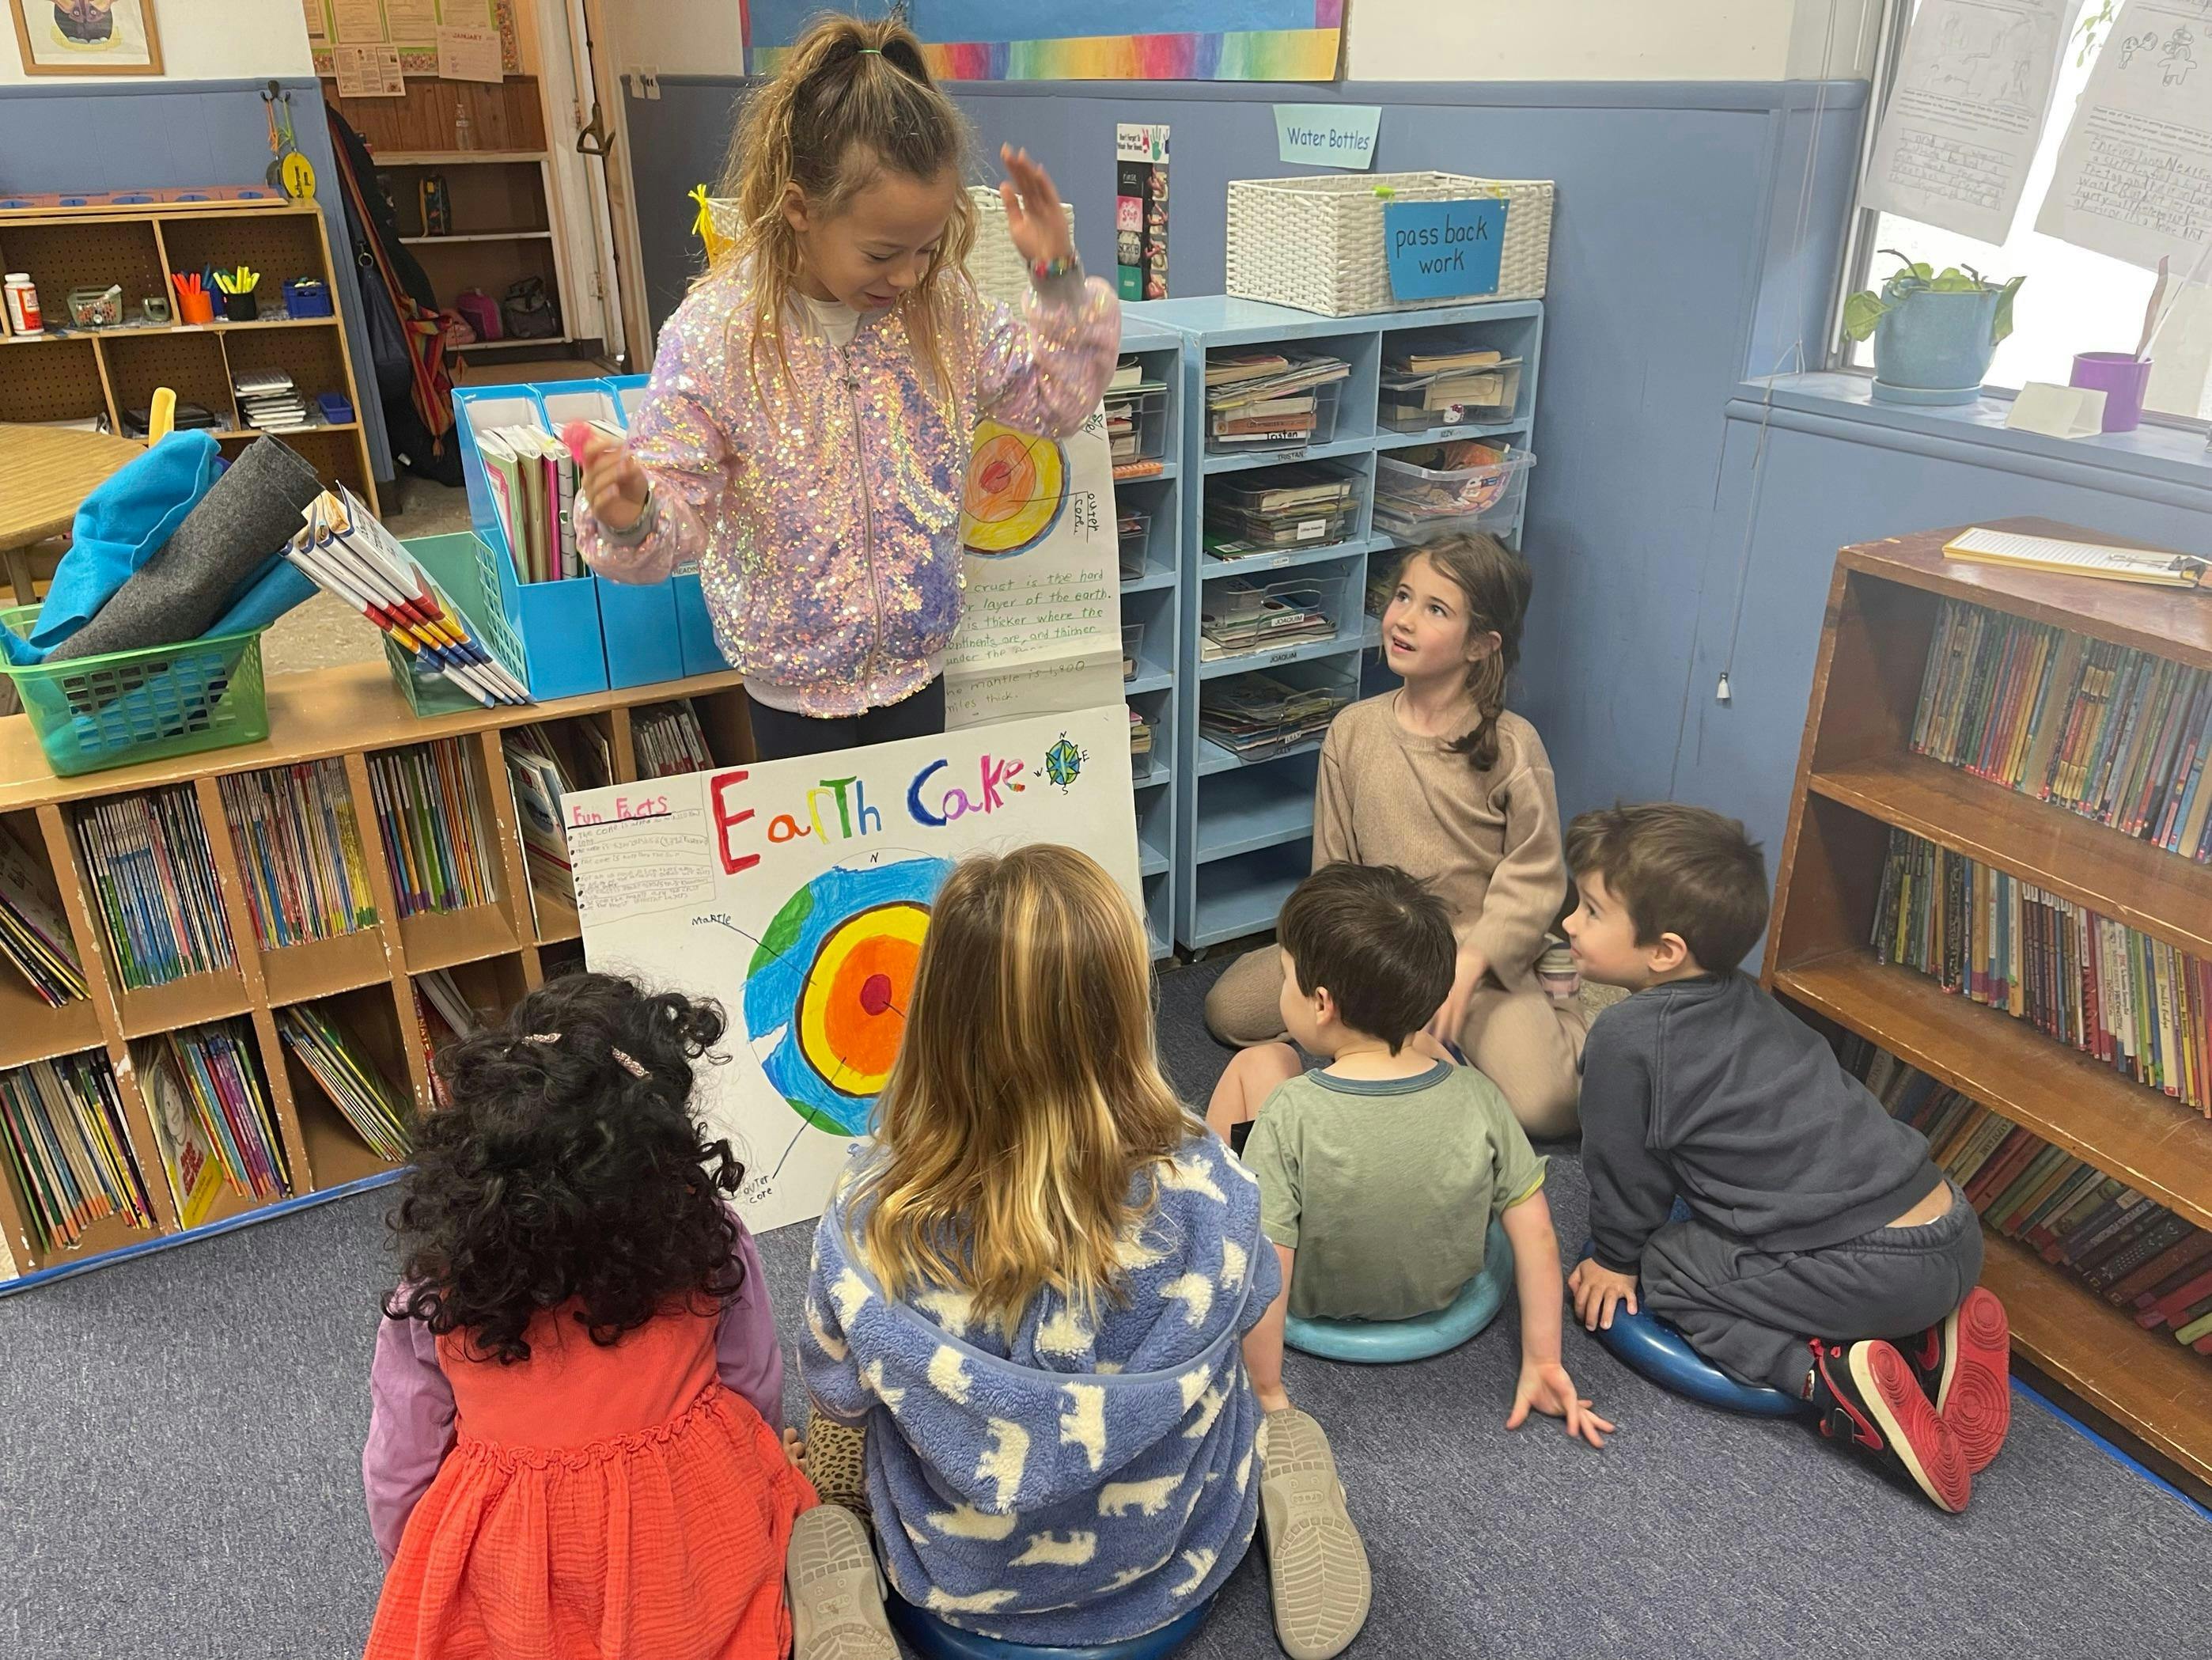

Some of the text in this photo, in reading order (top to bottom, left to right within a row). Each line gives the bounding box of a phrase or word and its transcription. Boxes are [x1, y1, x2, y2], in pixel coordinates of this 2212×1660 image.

[1287, 127, 1370, 150] Water Bottles
[1396, 214, 1487, 258] pass back
[1119, 244, 1138, 255] SCRUB
[1419, 248, 1464, 274] work
[1266, 430, 1298, 440] Tristan
[1278, 450, 1304, 460] TRISTAN
[673, 567, 696, 575] READIN
[974, 569, 1103, 593] crust is the hard
[983, 598, 1016, 613] layer
[1025, 593, 1044, 604] of
[1050, 588, 1069, 601] the
[1075, 589, 1111, 601] earth.
[968, 617, 978, 630] is
[1037, 611, 1073, 623] where
[1082, 608, 1103, 618] the
[1275, 615, 1302, 625] JOAQUIM
[1030, 628, 1048, 641] and
[1270, 652, 1297, 663] JOAQUIM
[970, 674, 1020, 691] mantle
[1082, 749, 1090, 762] E
[1033, 767, 1043, 777] W
[1062, 786, 1068, 796] S
[572, 805, 603, 827] Fun
[870, 851, 879, 863] N
